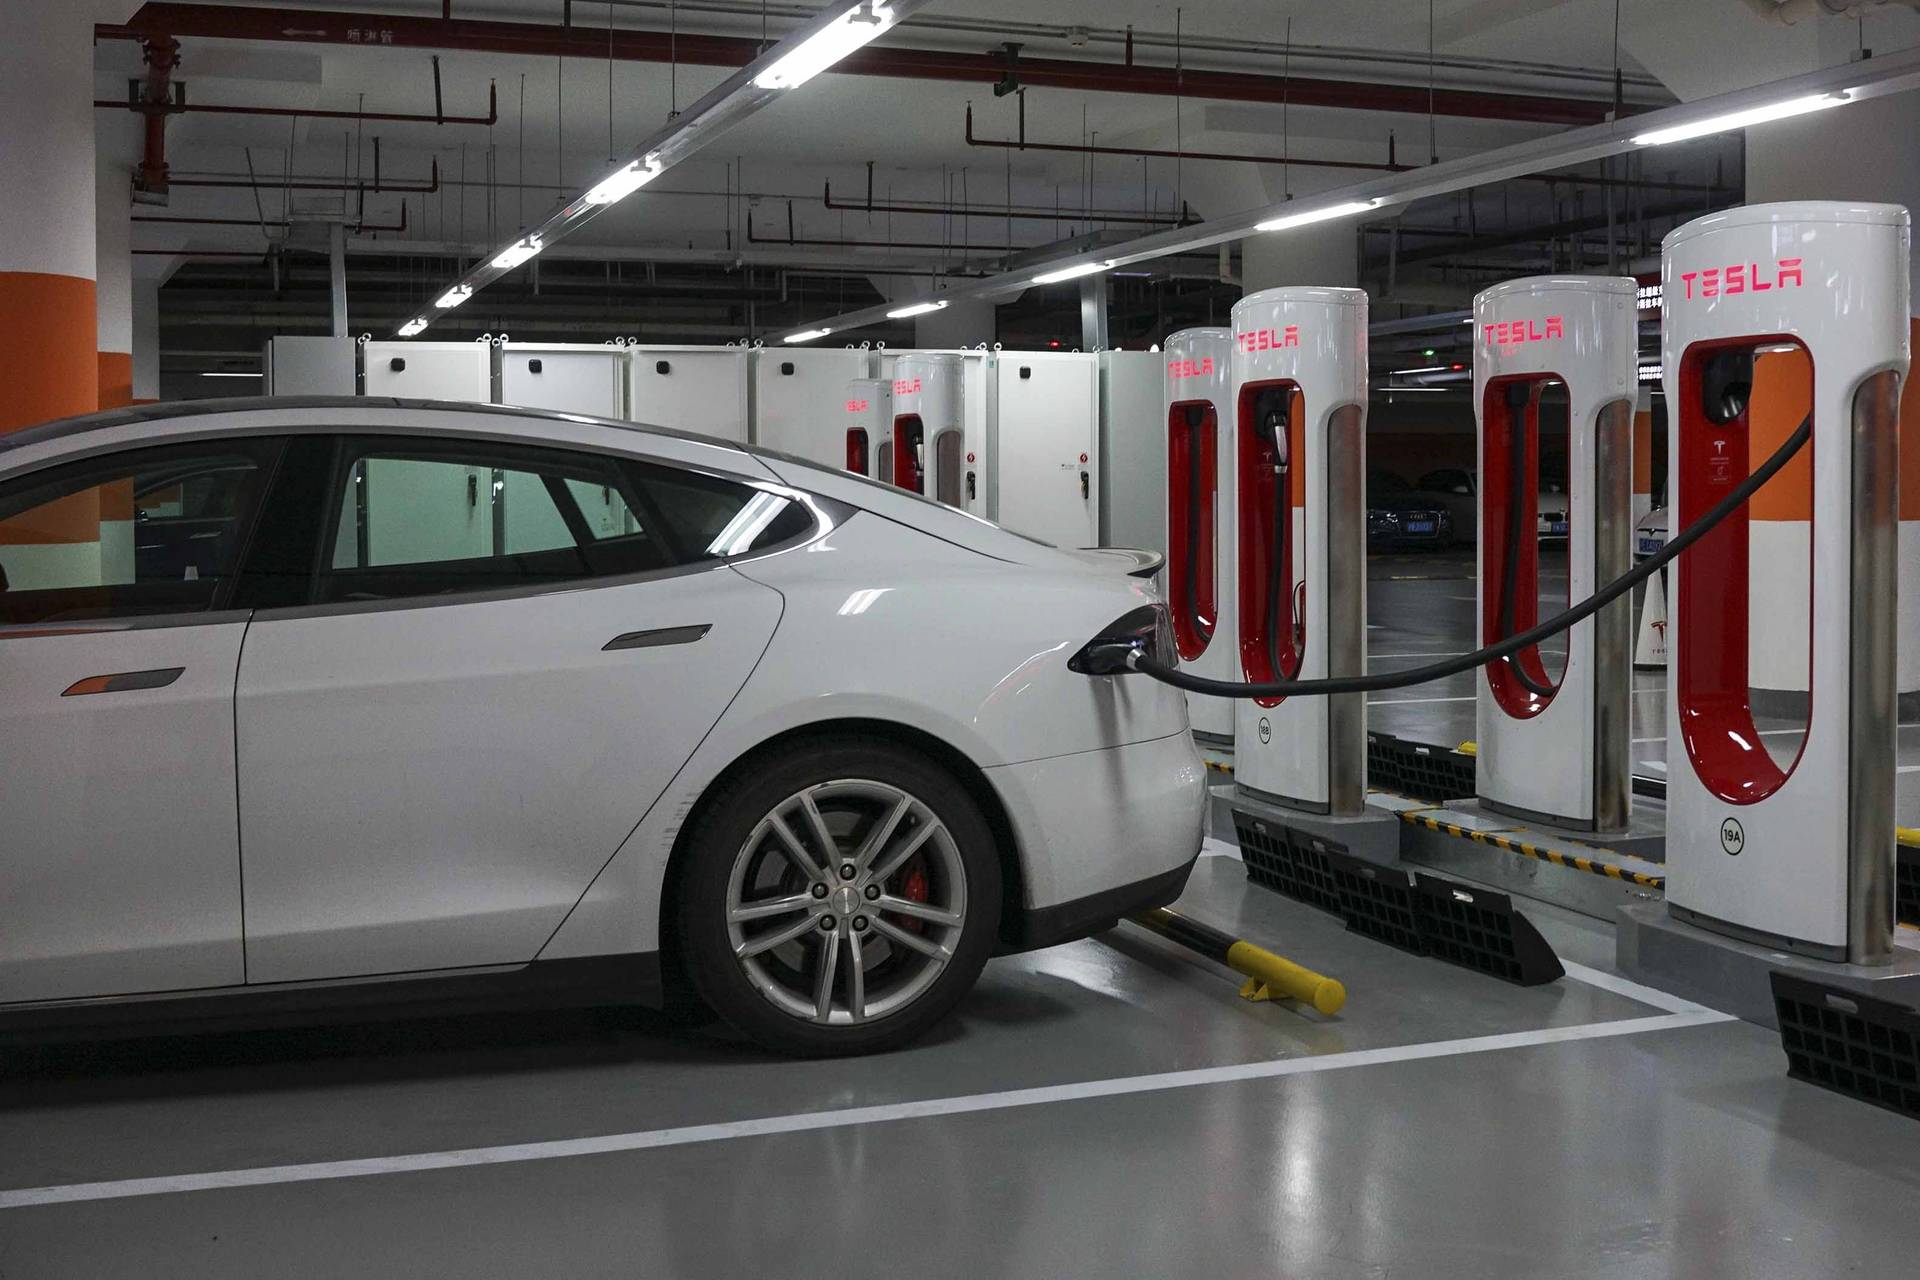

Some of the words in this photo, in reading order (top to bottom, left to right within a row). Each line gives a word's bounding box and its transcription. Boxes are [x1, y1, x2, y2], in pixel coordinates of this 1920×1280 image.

[1681, 258, 1803, 300] TESLA
[1238, 325, 1298, 352] TESLA
[1485, 316, 1563, 346] TESLA
[1168, 356, 1213, 379] TESLA
[1724, 829, 1741, 843] 19A
